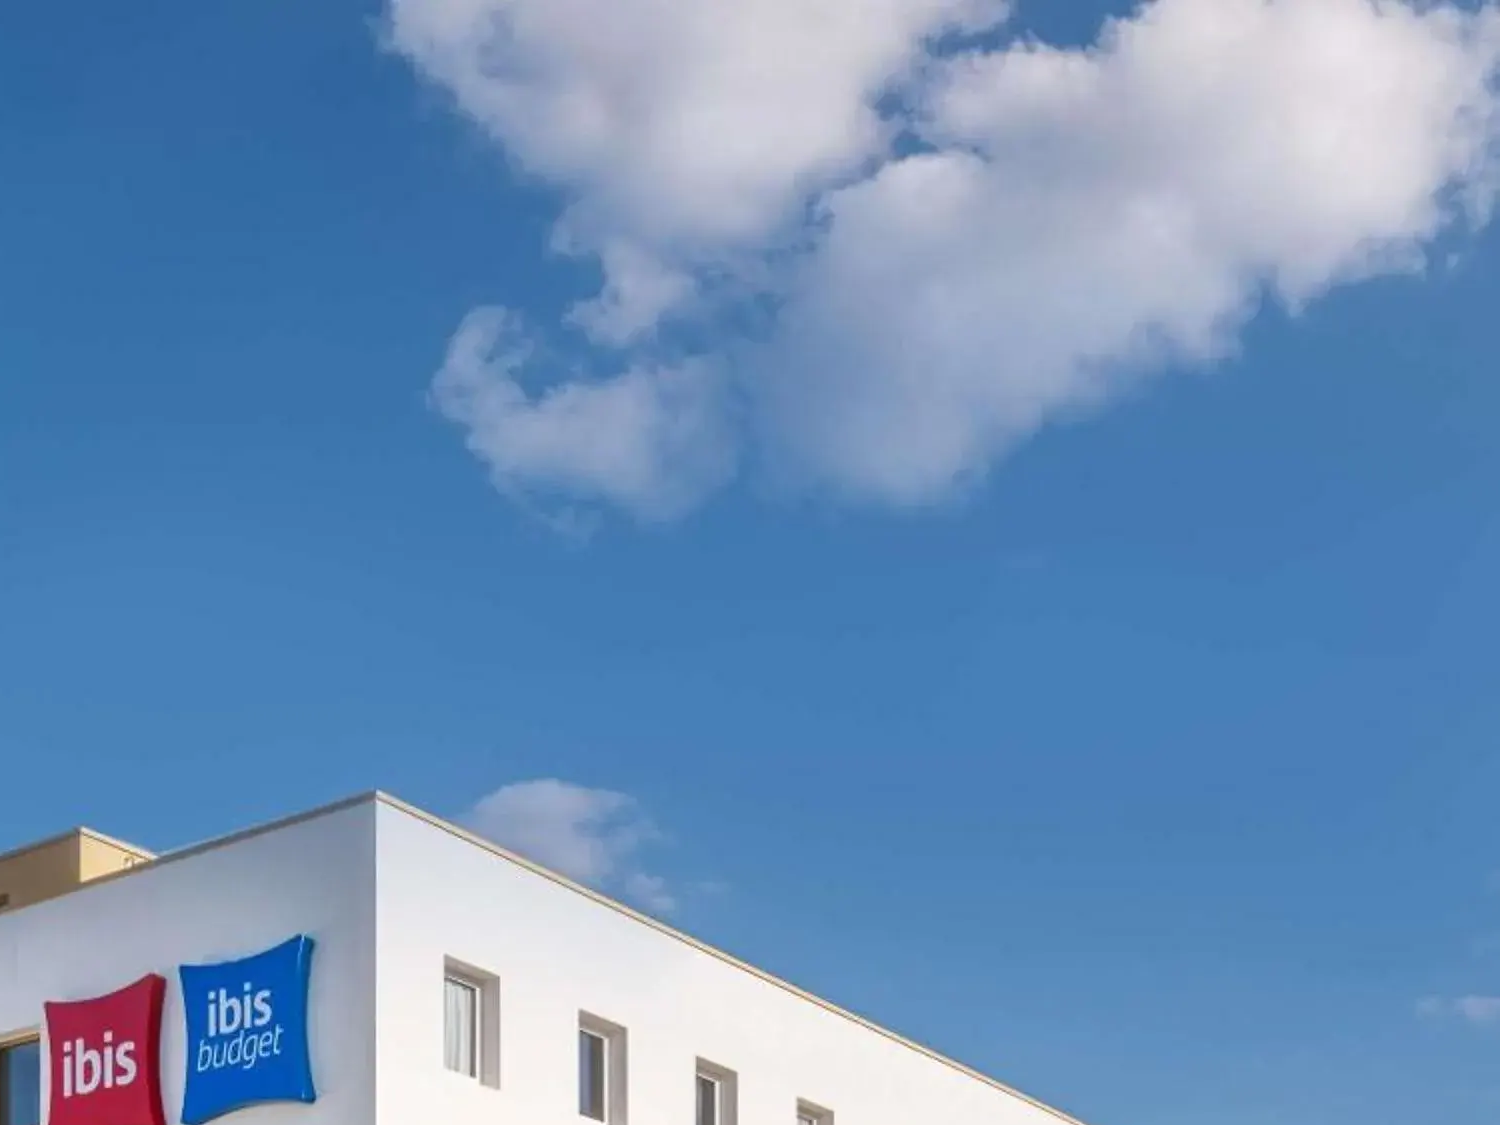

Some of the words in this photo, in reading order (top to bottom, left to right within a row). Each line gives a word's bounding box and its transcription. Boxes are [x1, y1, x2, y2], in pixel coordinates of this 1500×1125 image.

[206, 983, 272, 1037] ibis
[63, 1030, 137, 1097] ibis
[197, 1025, 284, 1071] budget
